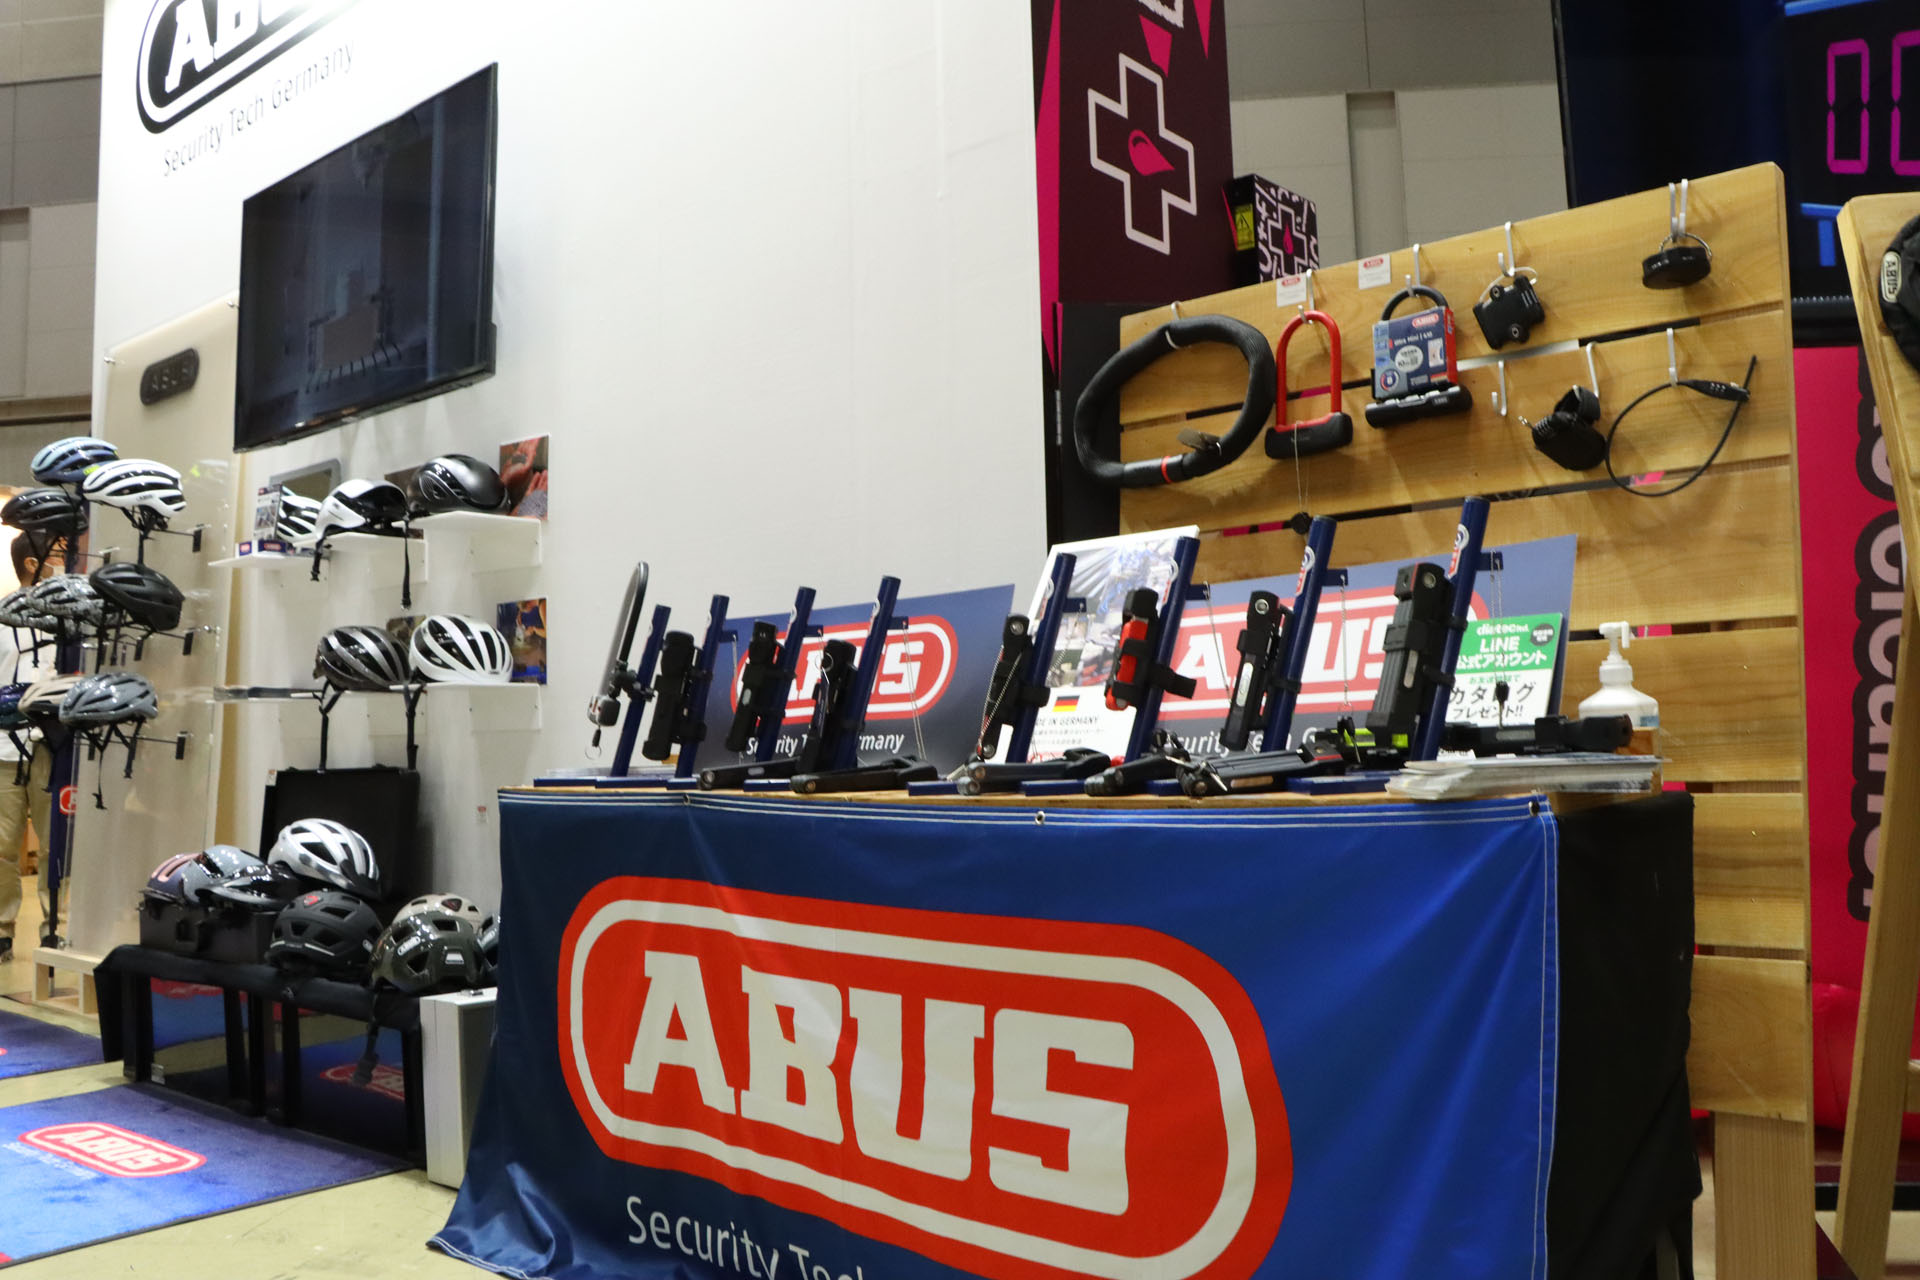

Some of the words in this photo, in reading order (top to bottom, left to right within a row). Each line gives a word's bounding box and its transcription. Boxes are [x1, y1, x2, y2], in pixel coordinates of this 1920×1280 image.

[163, 122, 223, 177] Security
[229, 95, 264, 137] Tech
[271, 43, 354, 110] Germany
[1886, 260, 1898, 295] ABUS
[1480, 635, 1520, 653] LINE
[1449, 680, 1537, 705] カタグ
[624, 950, 1134, 1216] ABUS
[44, 1129, 179, 1170] ABUS
[627, 1196, 779, 1280] Security
